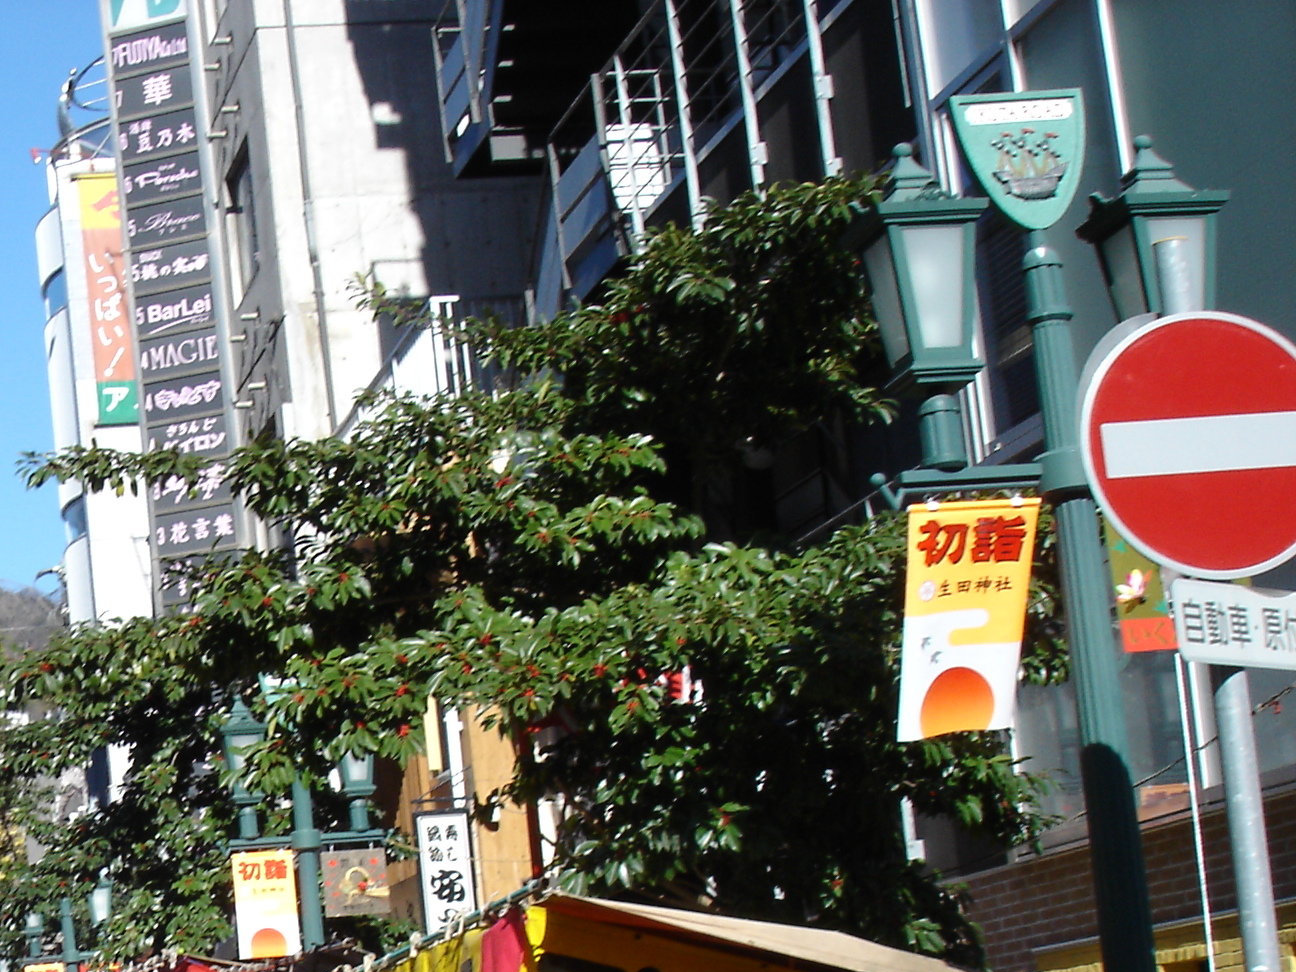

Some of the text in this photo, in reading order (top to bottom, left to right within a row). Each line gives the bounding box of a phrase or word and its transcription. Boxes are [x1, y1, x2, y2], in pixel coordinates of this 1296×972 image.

[142, 74, 172, 105] 華
[147, 294, 212, 324] BarLei
[150, 335, 218, 371] MAGIE
[170, 513, 235, 544] 花言葉
[916, 515, 1026, 568] 初詣
[938, 576, 1013, 597] 生田神社
[238, 859, 288, 881] 初詣
